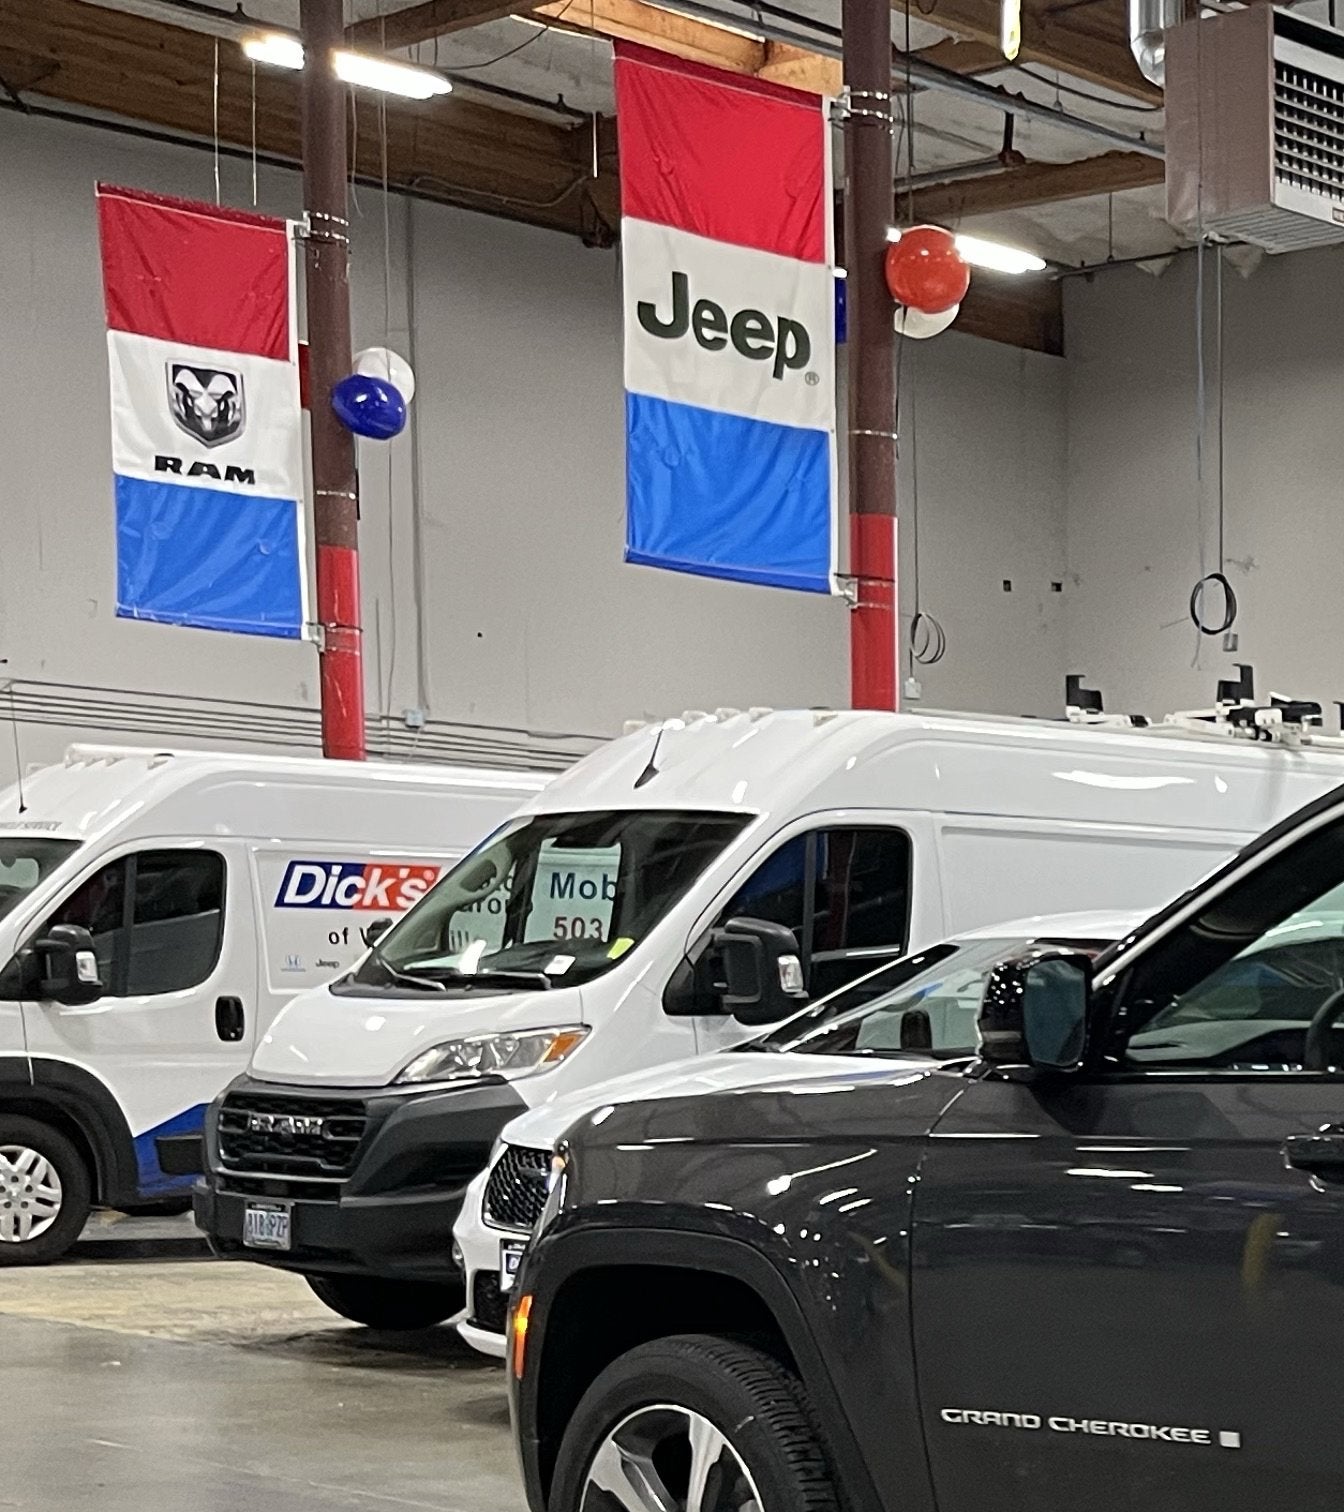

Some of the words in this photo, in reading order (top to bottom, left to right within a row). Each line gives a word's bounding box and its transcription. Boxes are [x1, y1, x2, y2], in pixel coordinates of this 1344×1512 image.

[636, 270, 811, 381] Jeep
[154, 455, 256, 486] RAM
[328, 926, 349, 945] of
[553, 916, 604, 940] 503
[940, 1407, 1042, 1430] GRAND
[1048, 1416, 1212, 1445] CHEROKEE
